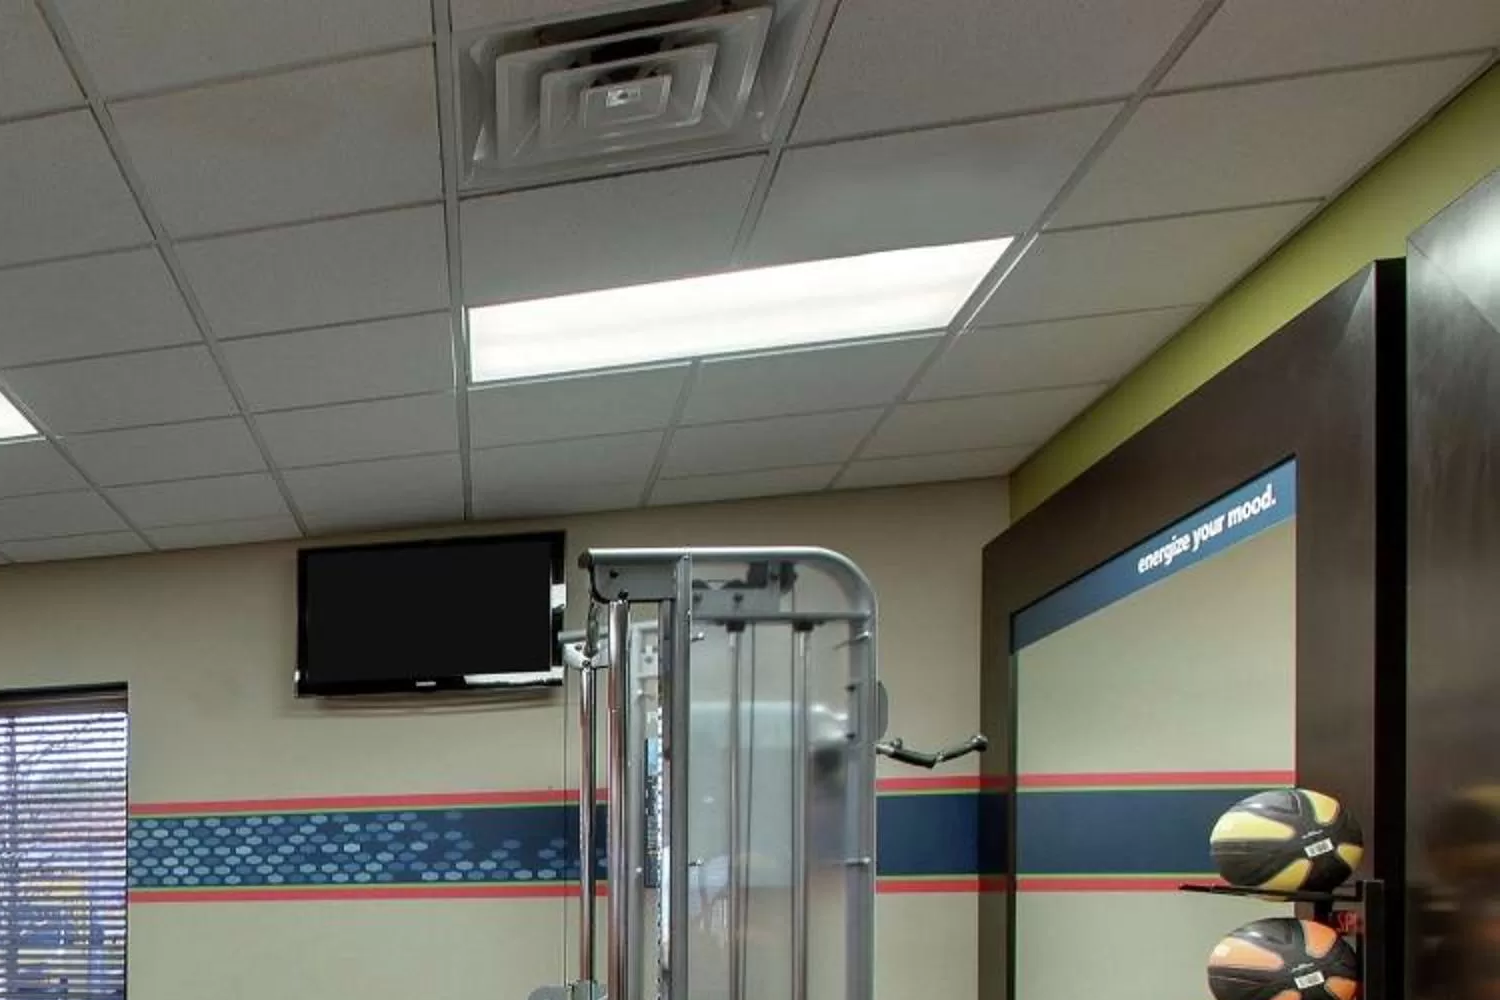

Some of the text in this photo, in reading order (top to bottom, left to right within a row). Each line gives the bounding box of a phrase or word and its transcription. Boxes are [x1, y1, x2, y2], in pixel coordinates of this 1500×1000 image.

[1137, 482, 1277, 574] energize your mood.
